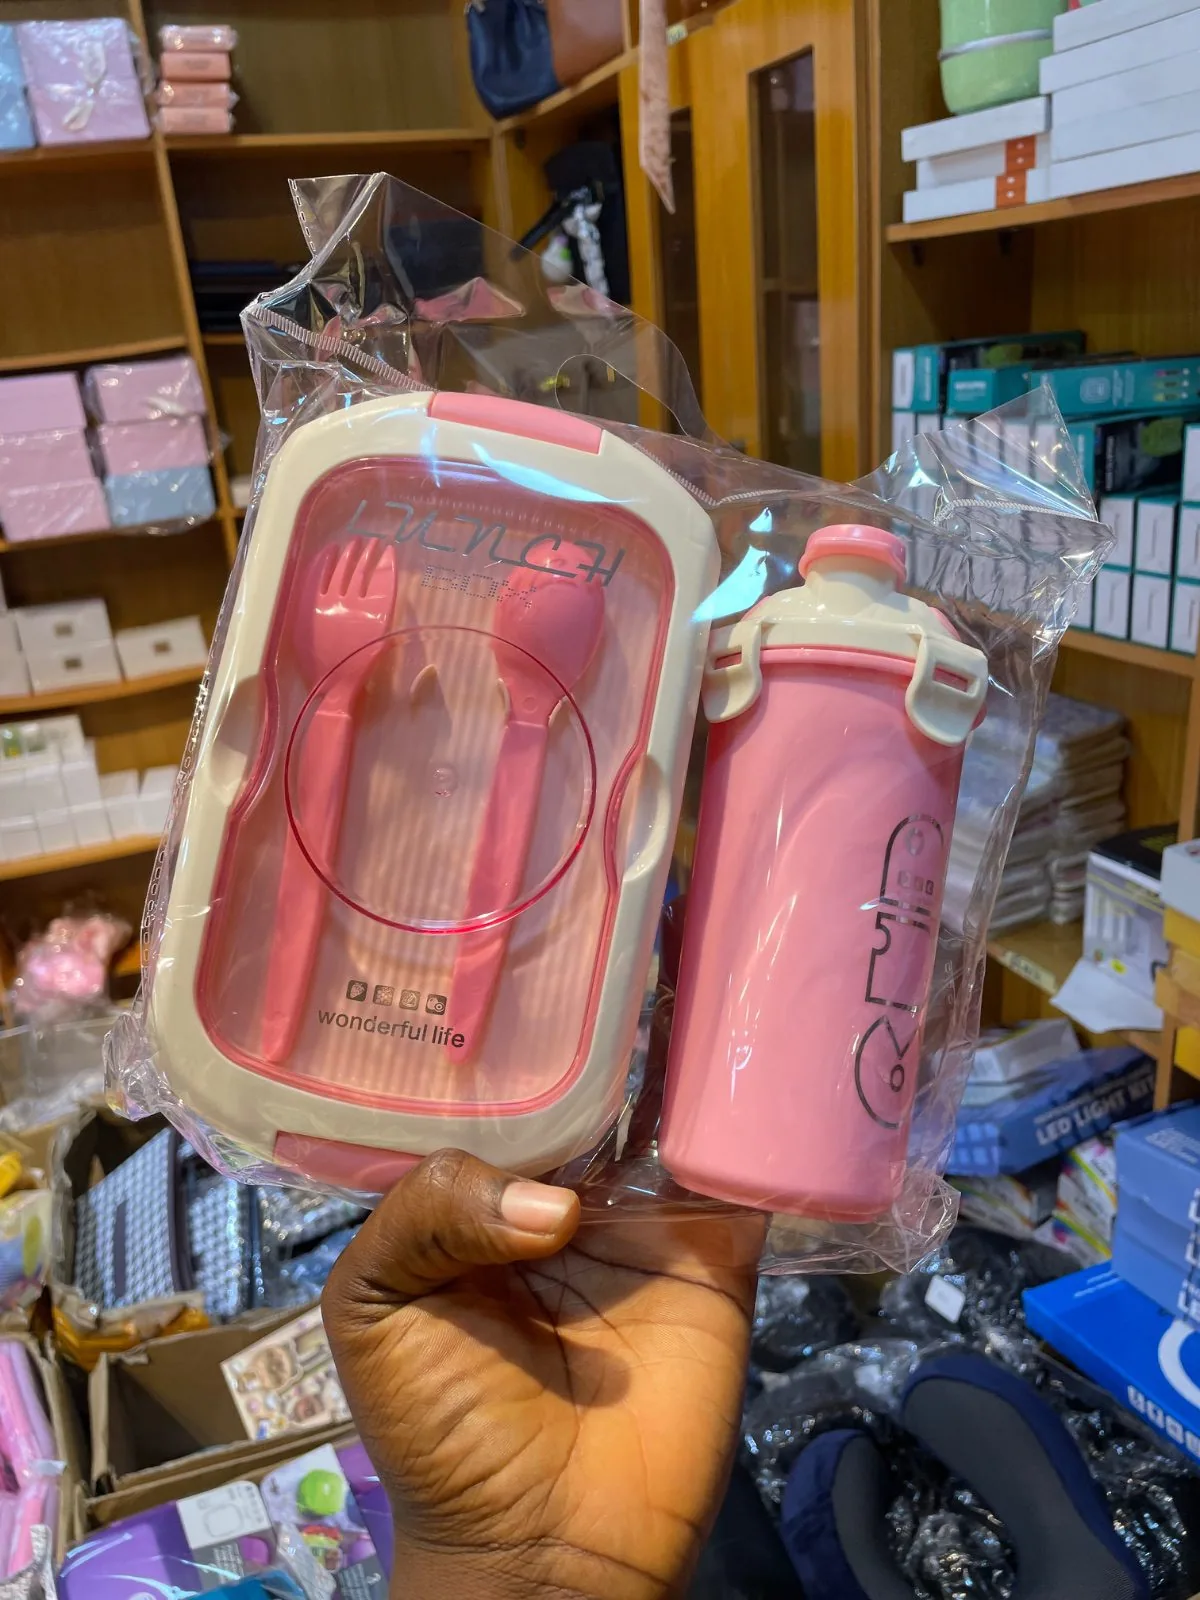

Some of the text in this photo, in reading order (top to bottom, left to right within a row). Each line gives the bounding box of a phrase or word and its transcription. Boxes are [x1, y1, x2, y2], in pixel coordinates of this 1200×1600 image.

[318, 1010, 465, 1048] wonderful life
[1036, 1115, 1072, 1145] LED
[1073, 1092, 1126, 1128] LIGHT
